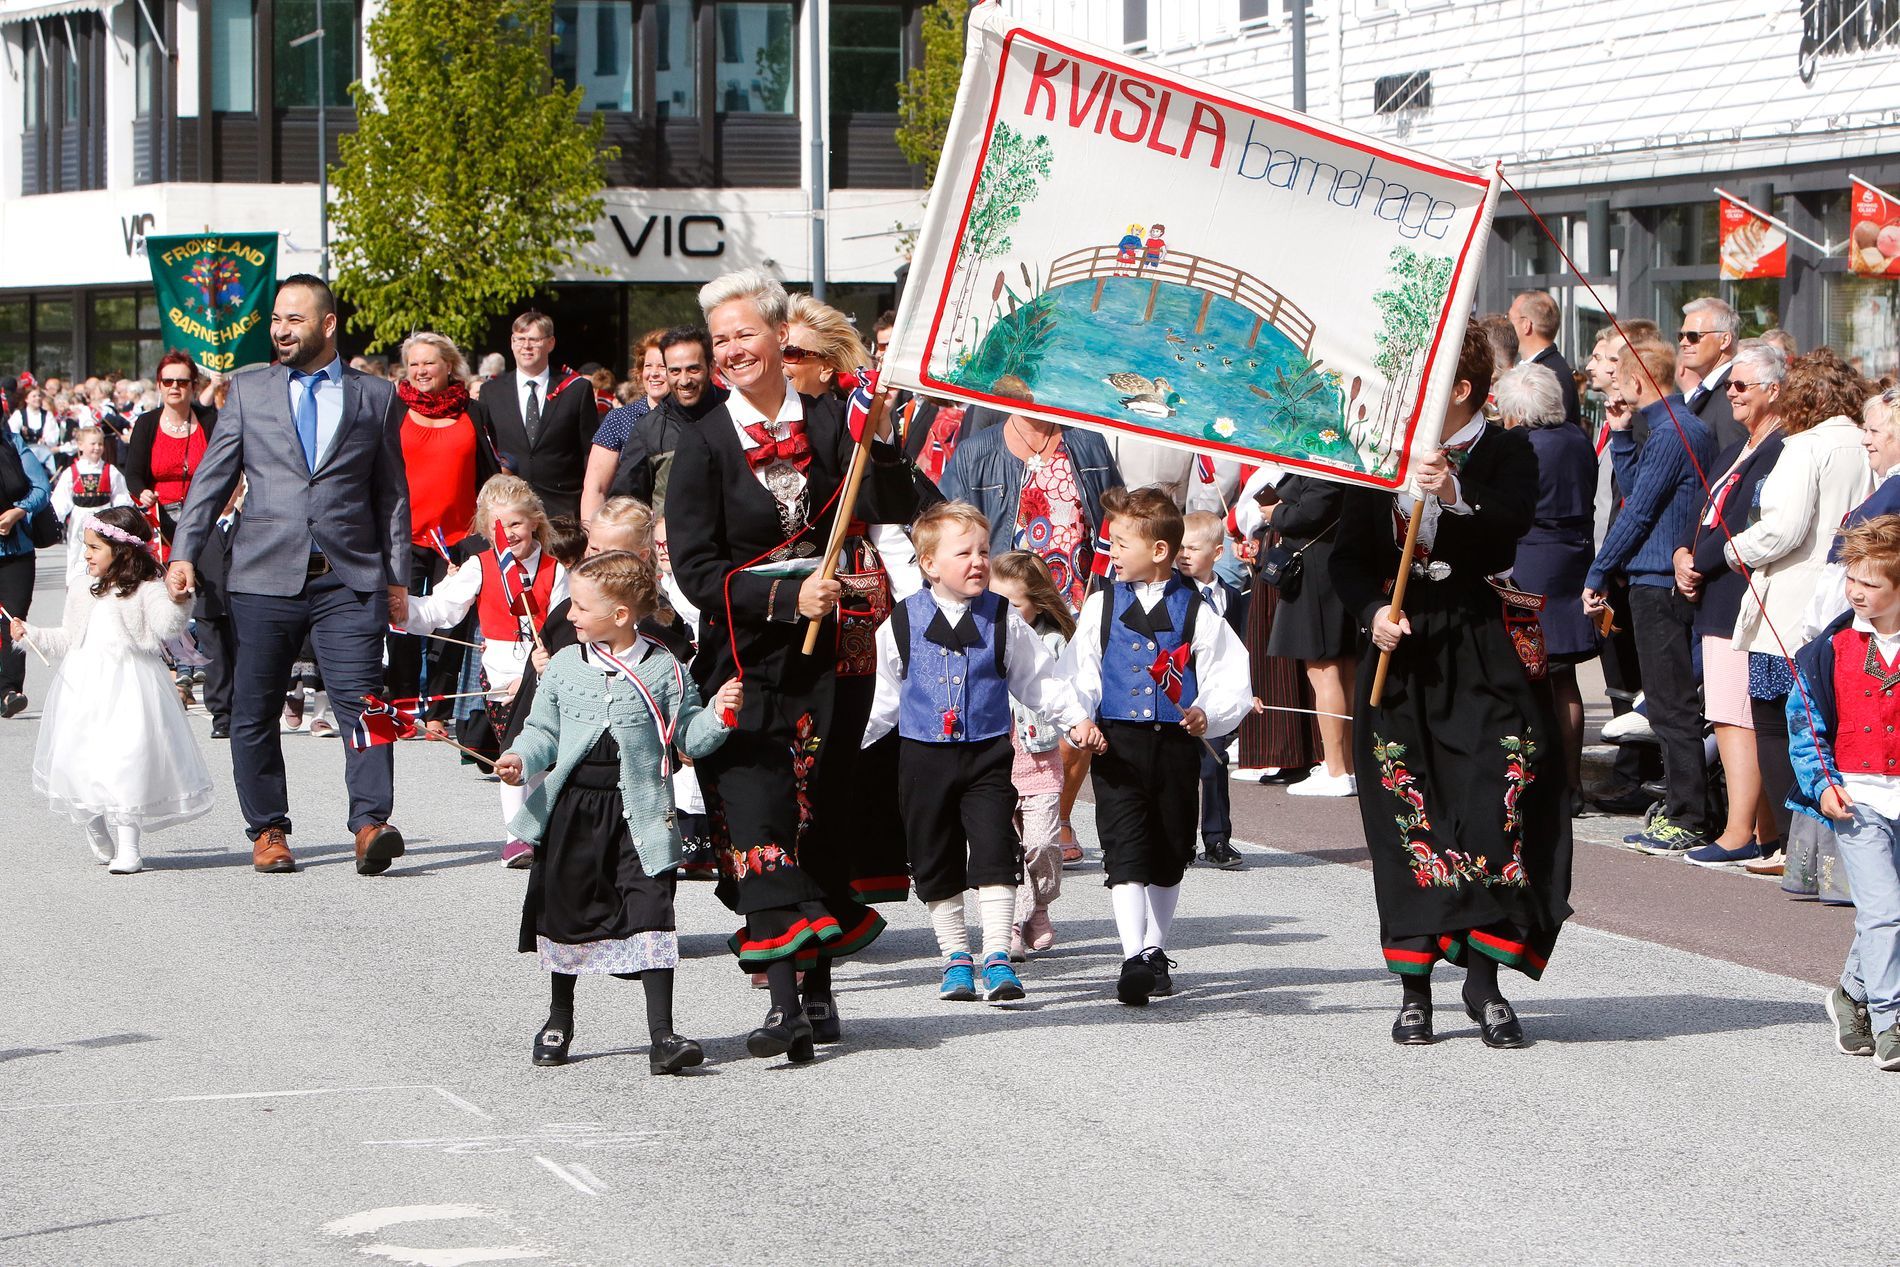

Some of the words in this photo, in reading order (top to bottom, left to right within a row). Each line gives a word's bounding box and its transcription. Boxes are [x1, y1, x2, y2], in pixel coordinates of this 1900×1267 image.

[1024, 53, 1226, 169] KVISLA
[1238, 120, 1456, 239] barnehage
[161, 239, 265, 266] FRØYSLAND
[610, 215, 725, 257] VIC
[168, 307, 262, 346] BARNEHAGE
[199, 351, 235, 370] 1992
